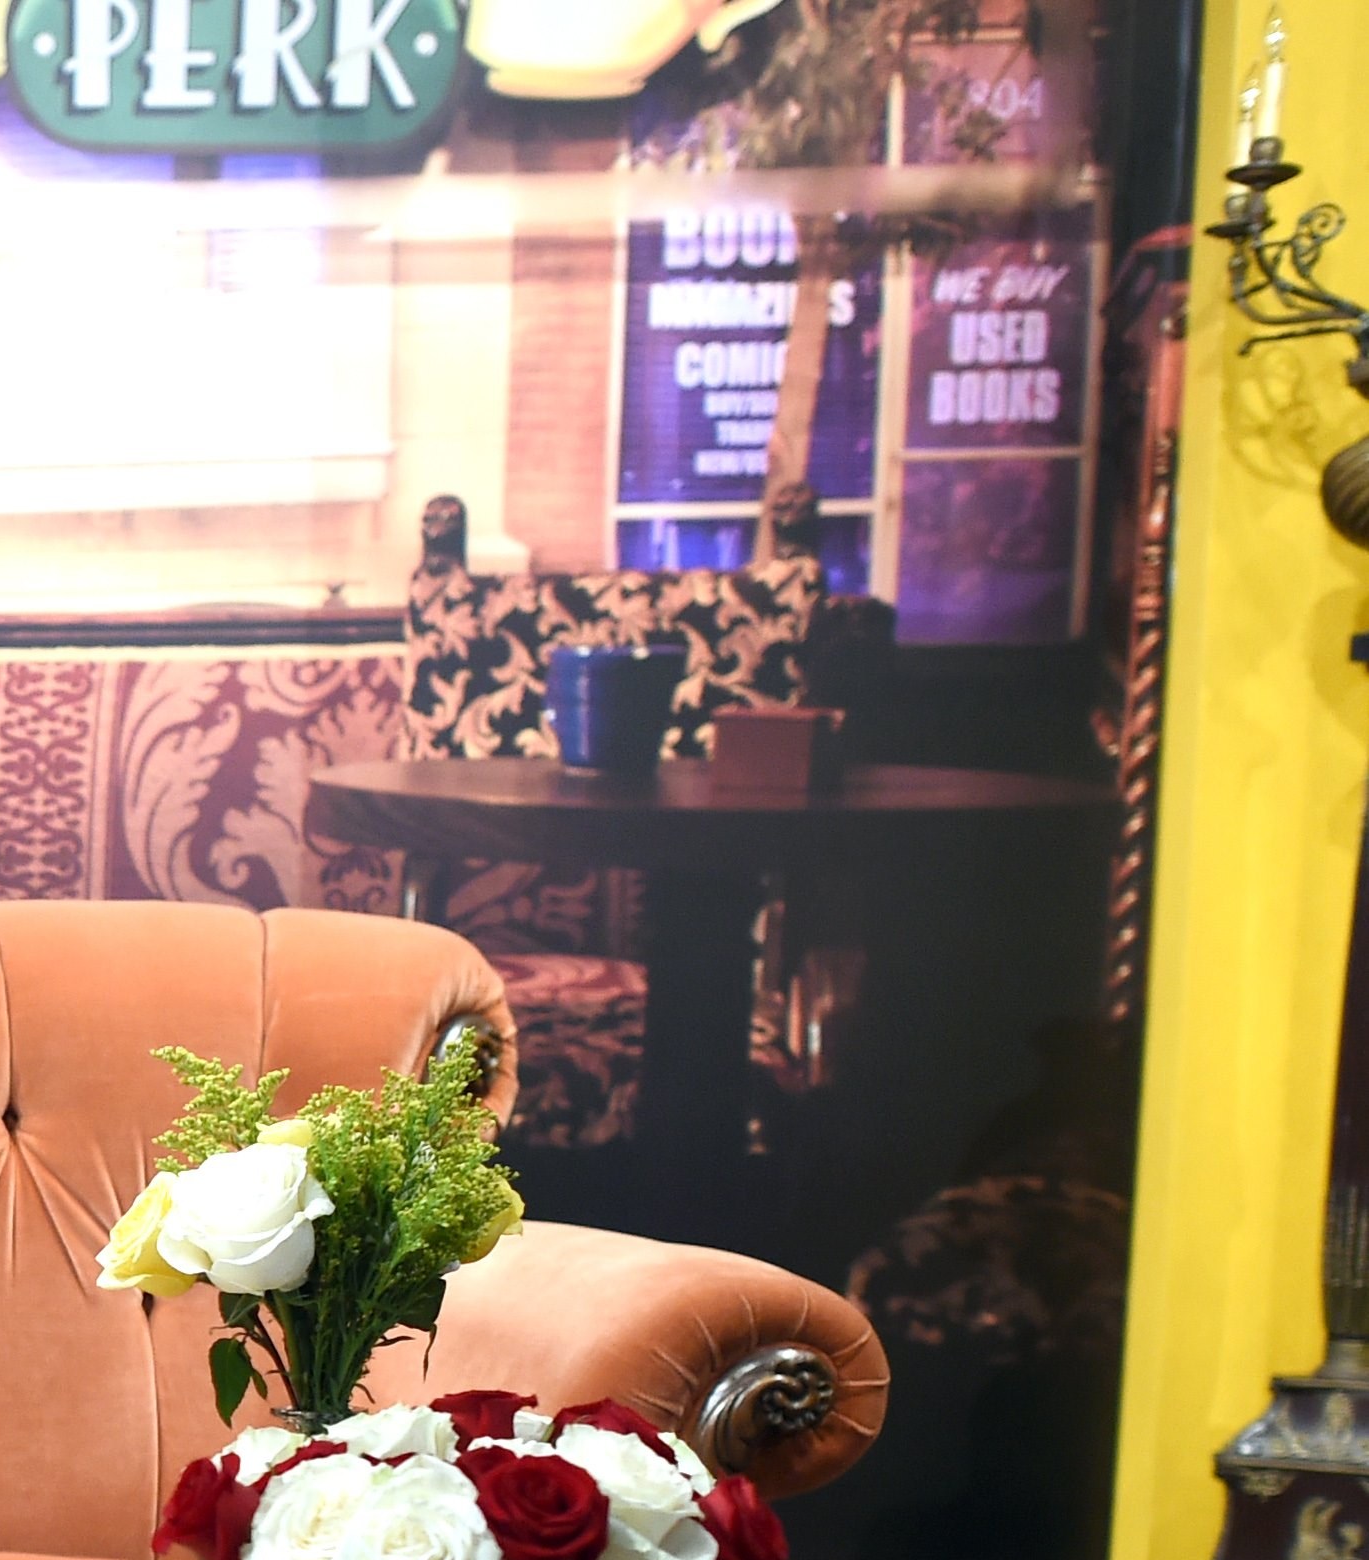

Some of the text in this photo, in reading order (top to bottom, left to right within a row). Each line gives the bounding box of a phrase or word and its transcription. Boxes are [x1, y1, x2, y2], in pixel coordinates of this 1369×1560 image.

[62, 0, 417, 109] PERK
[934, 264, 1069, 304] WE BUY
[950, 310, 1049, 365] USED
[929, 367, 1061, 425] BOOKS
